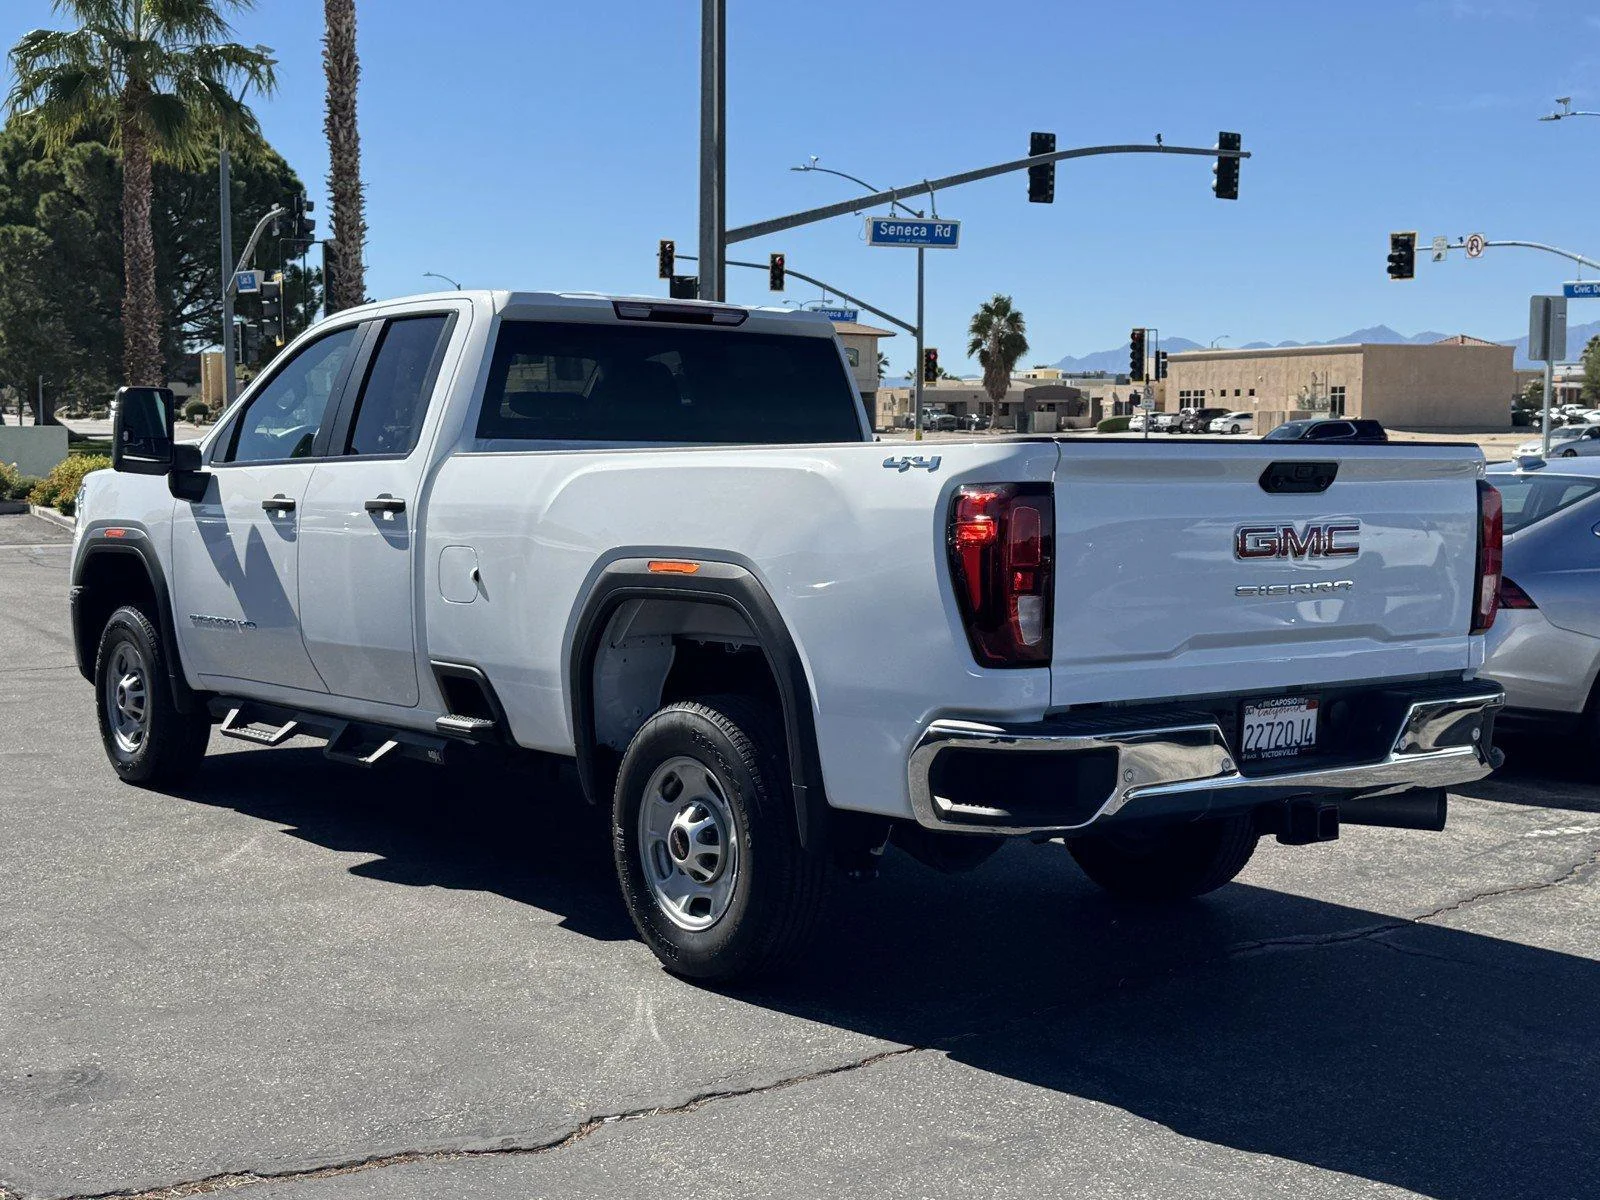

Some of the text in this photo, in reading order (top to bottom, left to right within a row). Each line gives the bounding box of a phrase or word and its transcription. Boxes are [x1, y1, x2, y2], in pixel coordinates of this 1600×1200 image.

[880, 222, 951, 237] Seneca Rd
[1573, 284, 1591, 293] Civic
[1235, 525, 1360, 559] GMC
[1235, 580, 1354, 597] SIERRA
